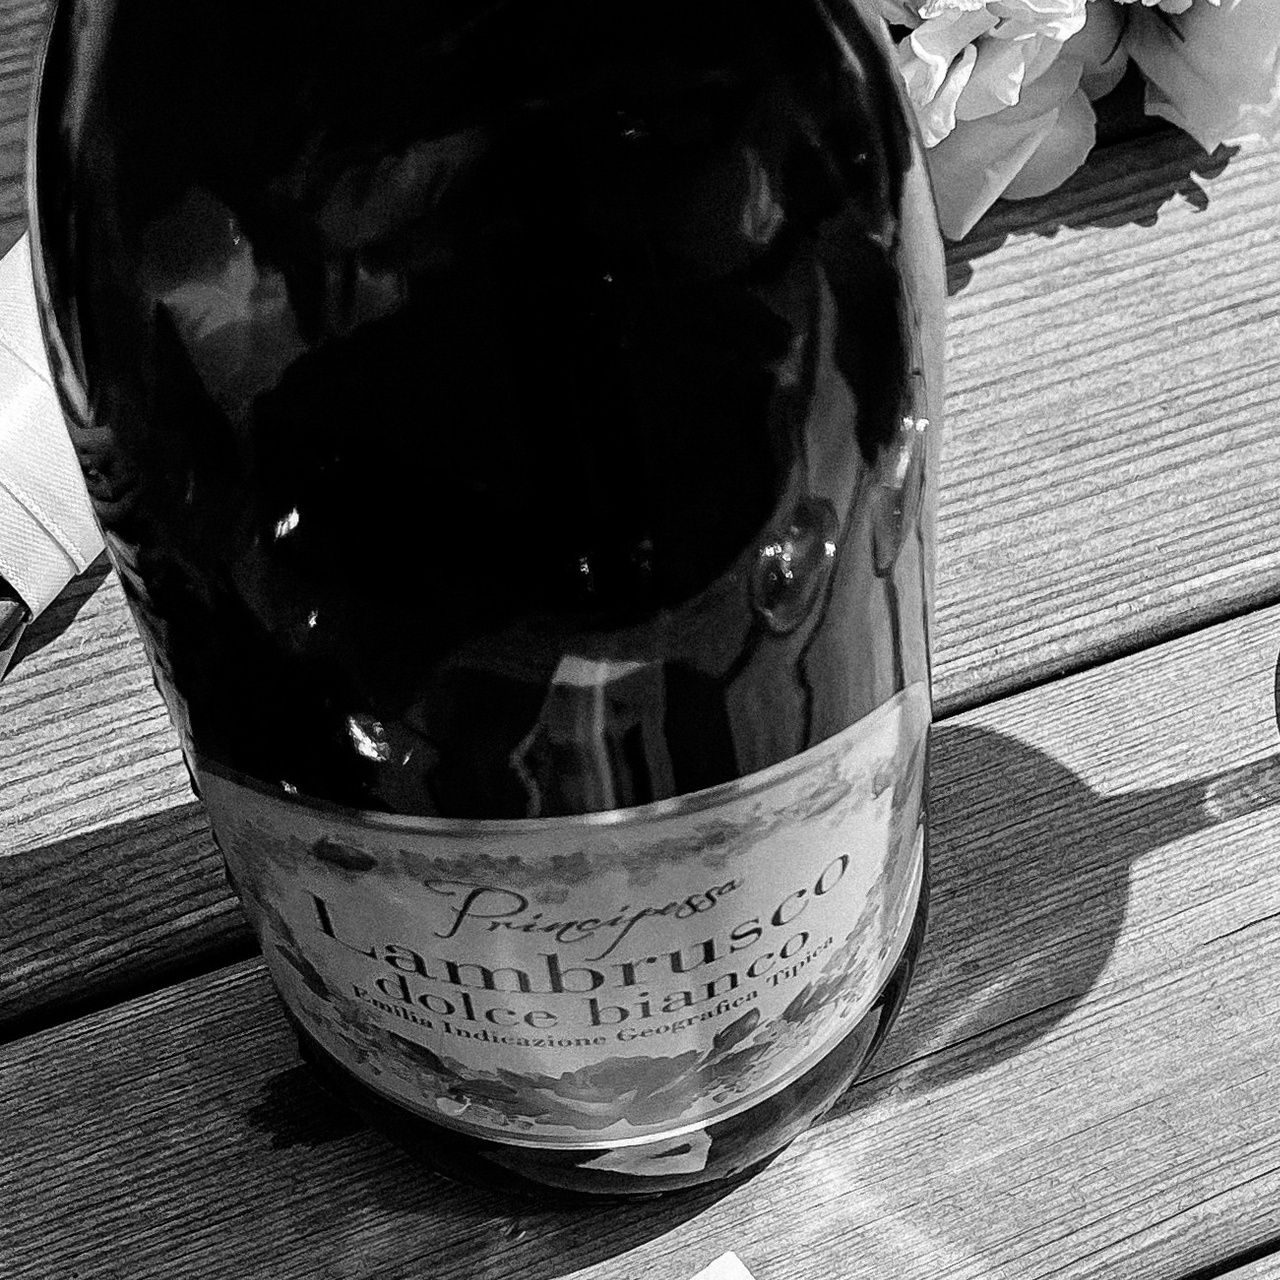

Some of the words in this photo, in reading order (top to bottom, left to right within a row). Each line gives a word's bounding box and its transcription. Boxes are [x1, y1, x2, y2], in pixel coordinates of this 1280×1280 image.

[310, 854, 849, 993] Lambrusco
[425, 878, 744, 959] Principessa
[353, 983, 433, 1028] Emilia
[444, 1020, 607, 1048] Indicazione
[616, 990, 757, 1042] Geografica
[766, 935, 834, 988] Tipica
[377, 973, 557, 1029] dolce
[588, 931, 809, 1026] bianco
